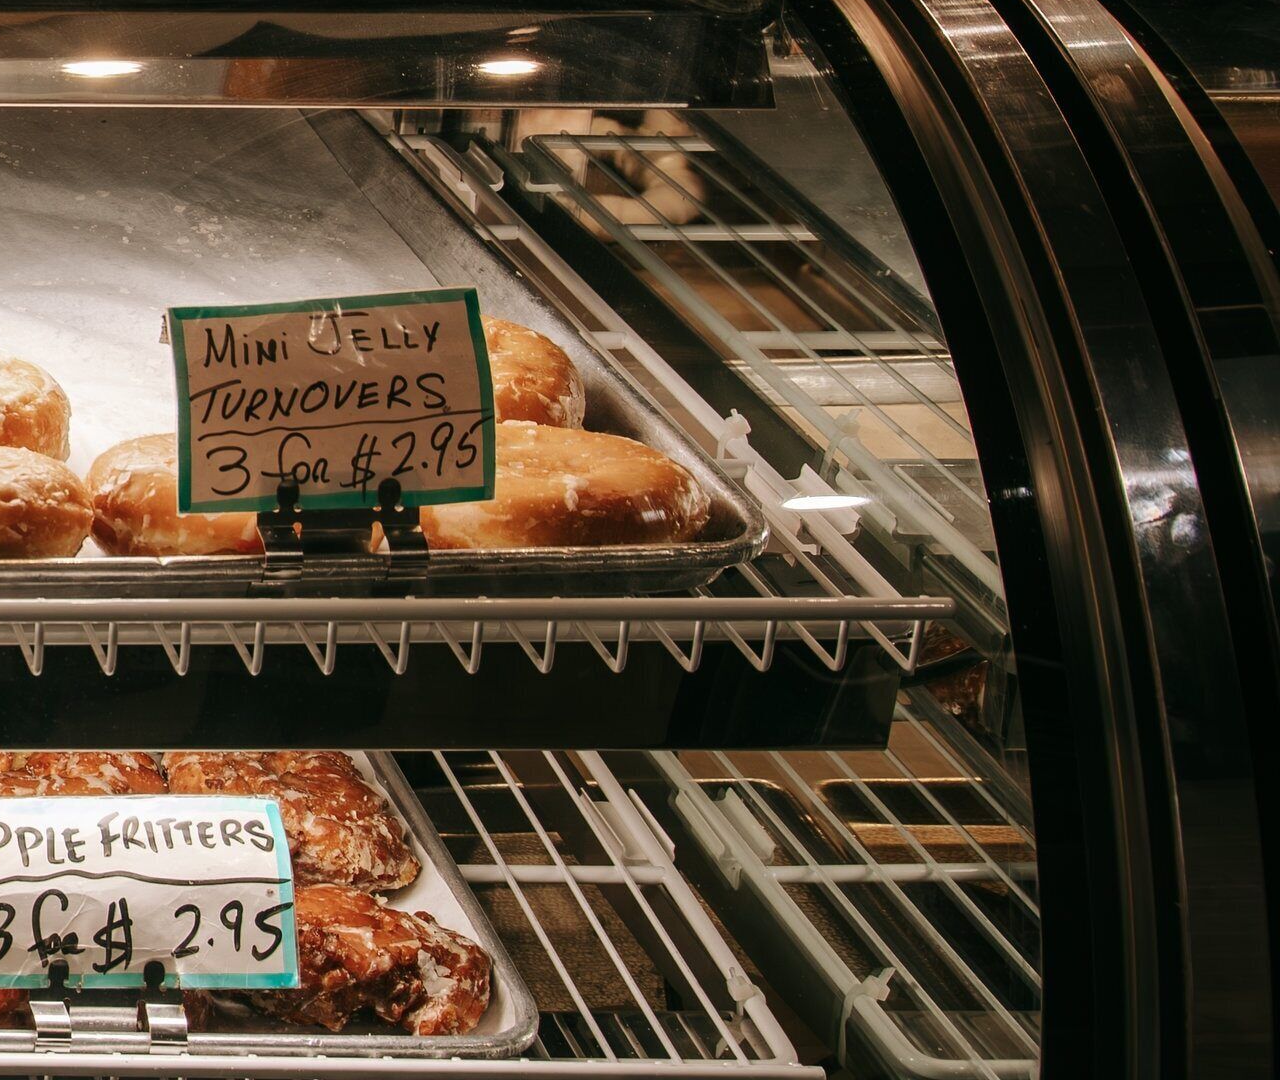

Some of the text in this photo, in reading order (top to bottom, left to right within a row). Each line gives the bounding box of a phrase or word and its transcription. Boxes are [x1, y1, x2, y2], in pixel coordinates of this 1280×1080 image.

[306, 310, 441, 357] JELLY
[189, 371, 450, 424] TURNOVERS
[206, 445, 252, 496] 3
[96, 810, 276, 858] FRITTERS
